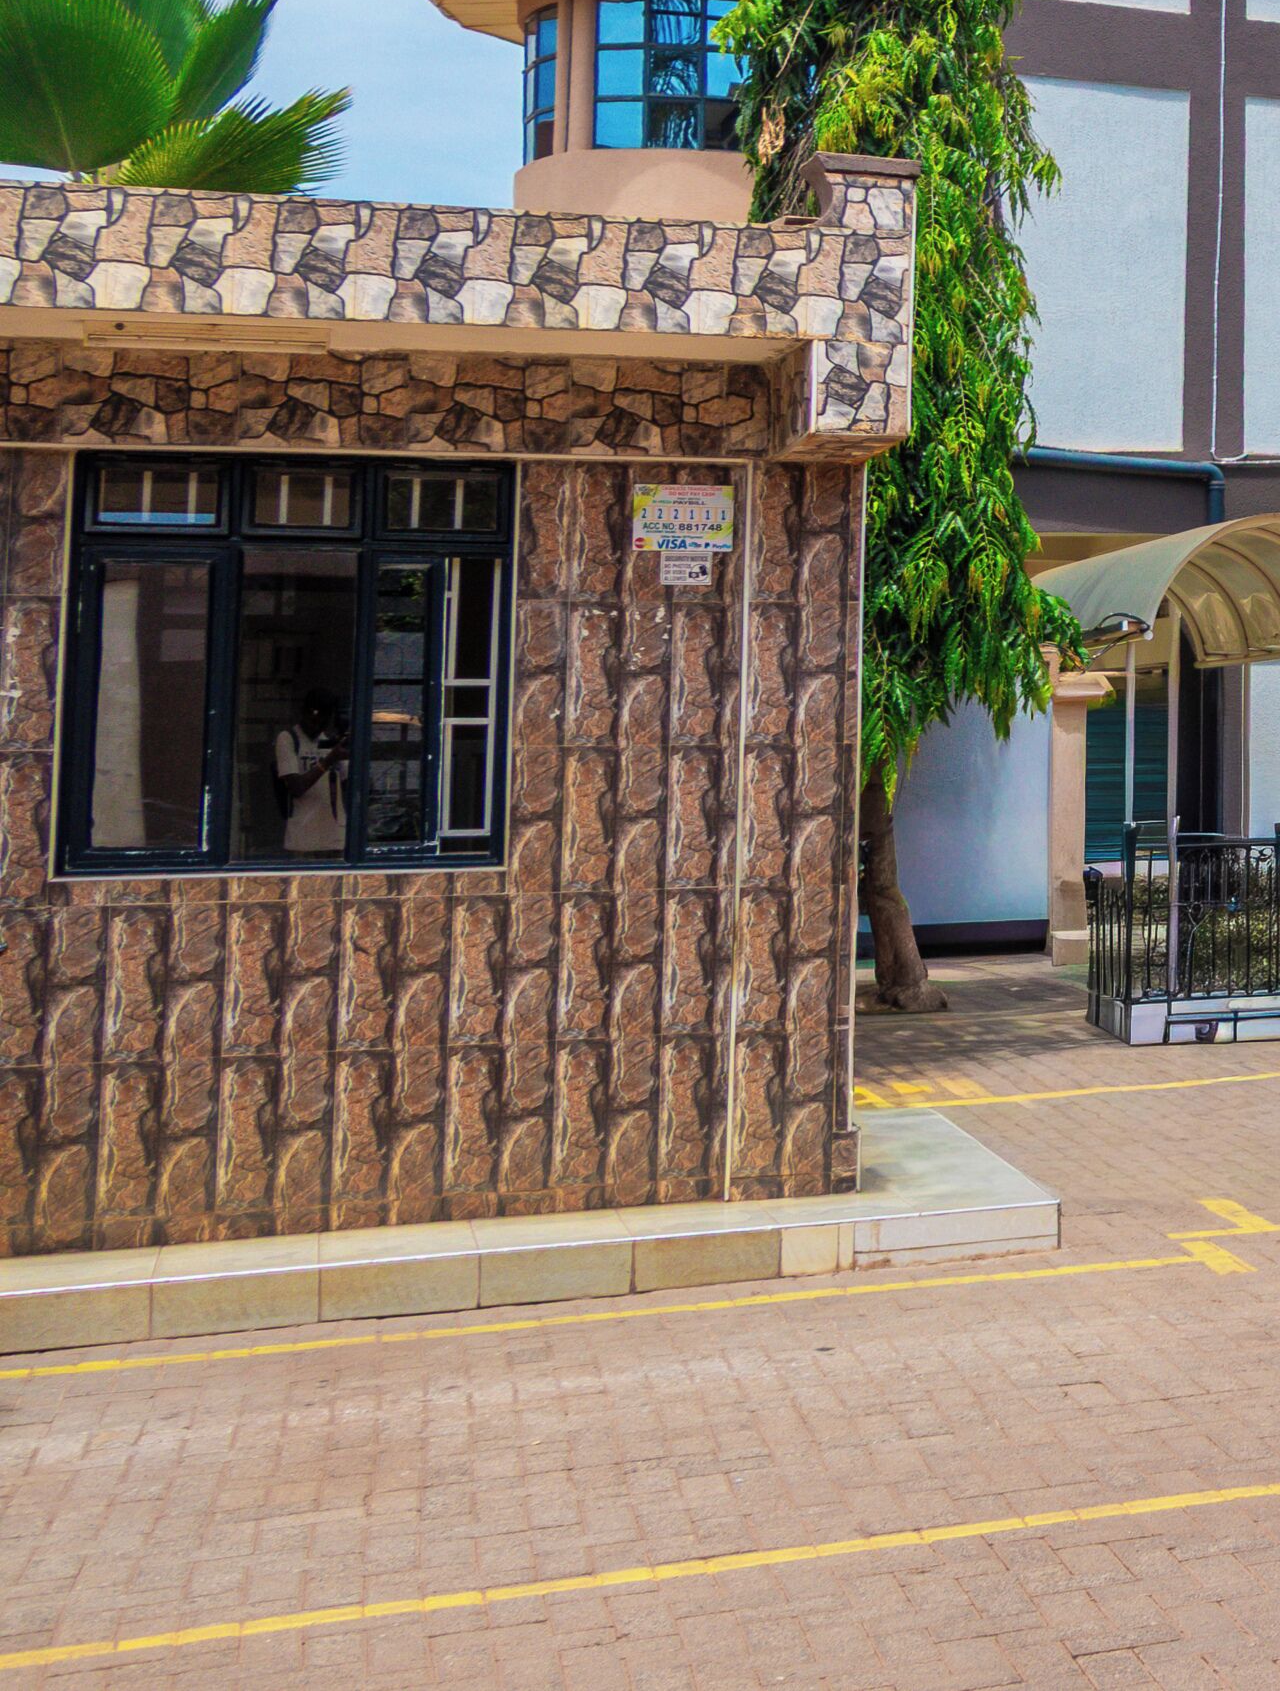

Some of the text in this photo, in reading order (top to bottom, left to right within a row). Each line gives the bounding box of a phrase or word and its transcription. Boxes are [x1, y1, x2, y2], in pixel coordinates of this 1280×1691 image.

[642, 522, 659, 530] ACC
[678, 523, 723, 531] 881748
[657, 539, 688, 549] VISA
